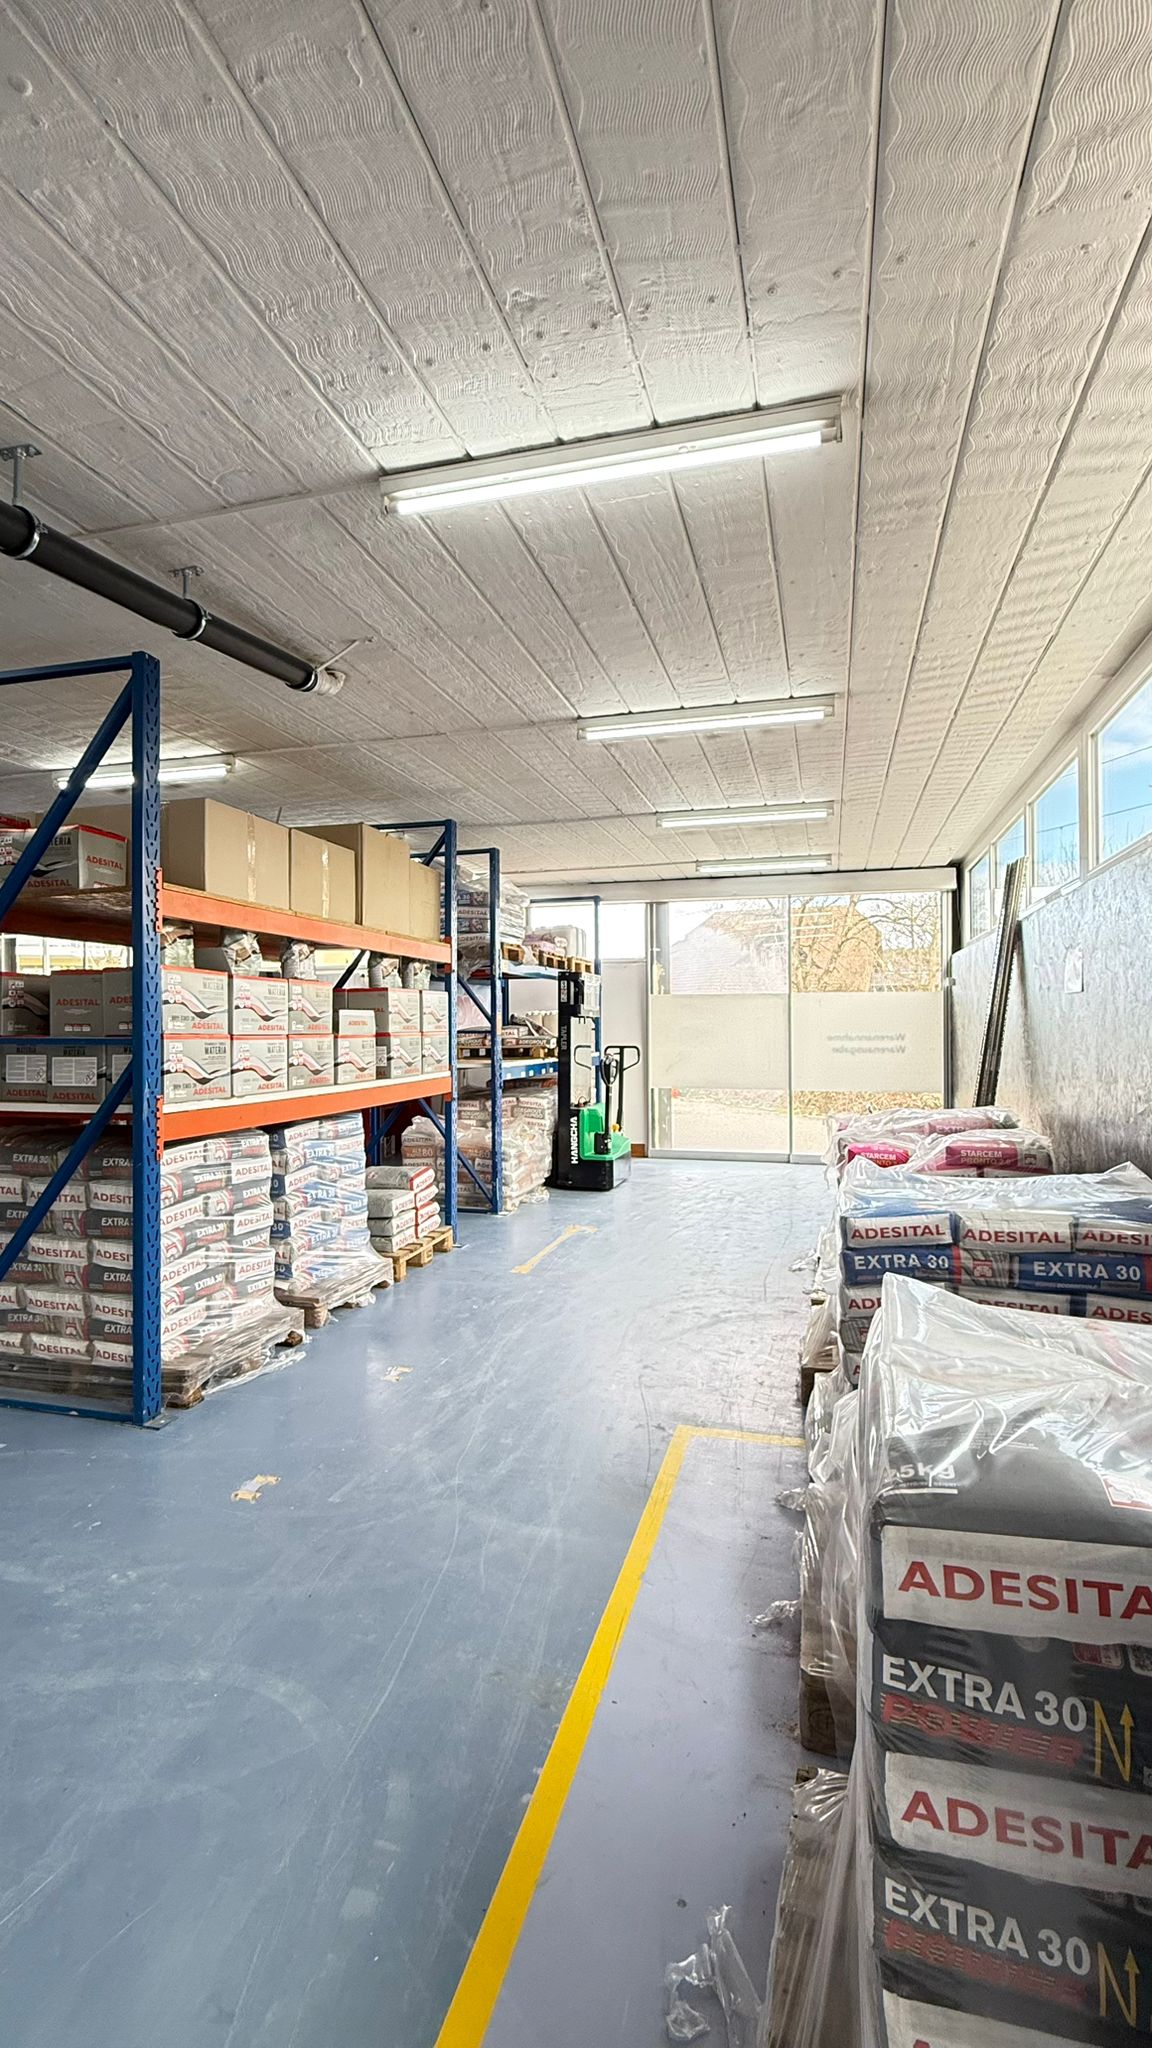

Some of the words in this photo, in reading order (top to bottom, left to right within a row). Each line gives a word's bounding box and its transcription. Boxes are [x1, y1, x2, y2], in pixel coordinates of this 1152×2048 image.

[85, 855, 124, 870] ADESITAL
[26, 879, 72, 888] ADESITAL
[55, 998, 100, 1007] ADESITAL
[191, 1022, 225, 1030] ADESITAL
[193, 1086, 227, 1096] ADESITAL
[256, 1081, 286, 1091] ADESITAL
[53, 1091, 97, 1101] ADESITAL
[13, 1153, 39, 1164] EXTRA
[960, 1150, 1003, 1158] STARCEM
[102, 1157, 130, 1167] EXTRA
[101, 1217, 130, 1227] EXTRA
[851, 1224, 946, 1240] ADESITAL
[962, 1228, 1066, 1243] ADESITAL
[1082, 1229, 1152, 1246] ADESI
[31, 1246, 86, 1260] ADESITAL
[854, 1253, 922, 1270] EXTRA
[927, 1254, 949, 1269] 30
[1033, 1261, 1109, 1279] EXTRA
[1116, 1265, 1141, 1280] 30
[103, 1272, 132, 1283] EXTRA
[28, 1298, 83, 1312] ADESITAL
[7, 1313, 33, 1323] EXTRA
[104, 1324, 132, 1334] EXTRA
[898, 1560, 1152, 1620] ADESITA
[882, 1653, 1026, 1721] EXTRA
[1034, 1690, 1087, 1733] 30
[900, 1790, 1152, 1870] ADESITA
[884, 1876, 1029, 1959] EXTRA
[1037, 1928, 1091, 1977] 30
